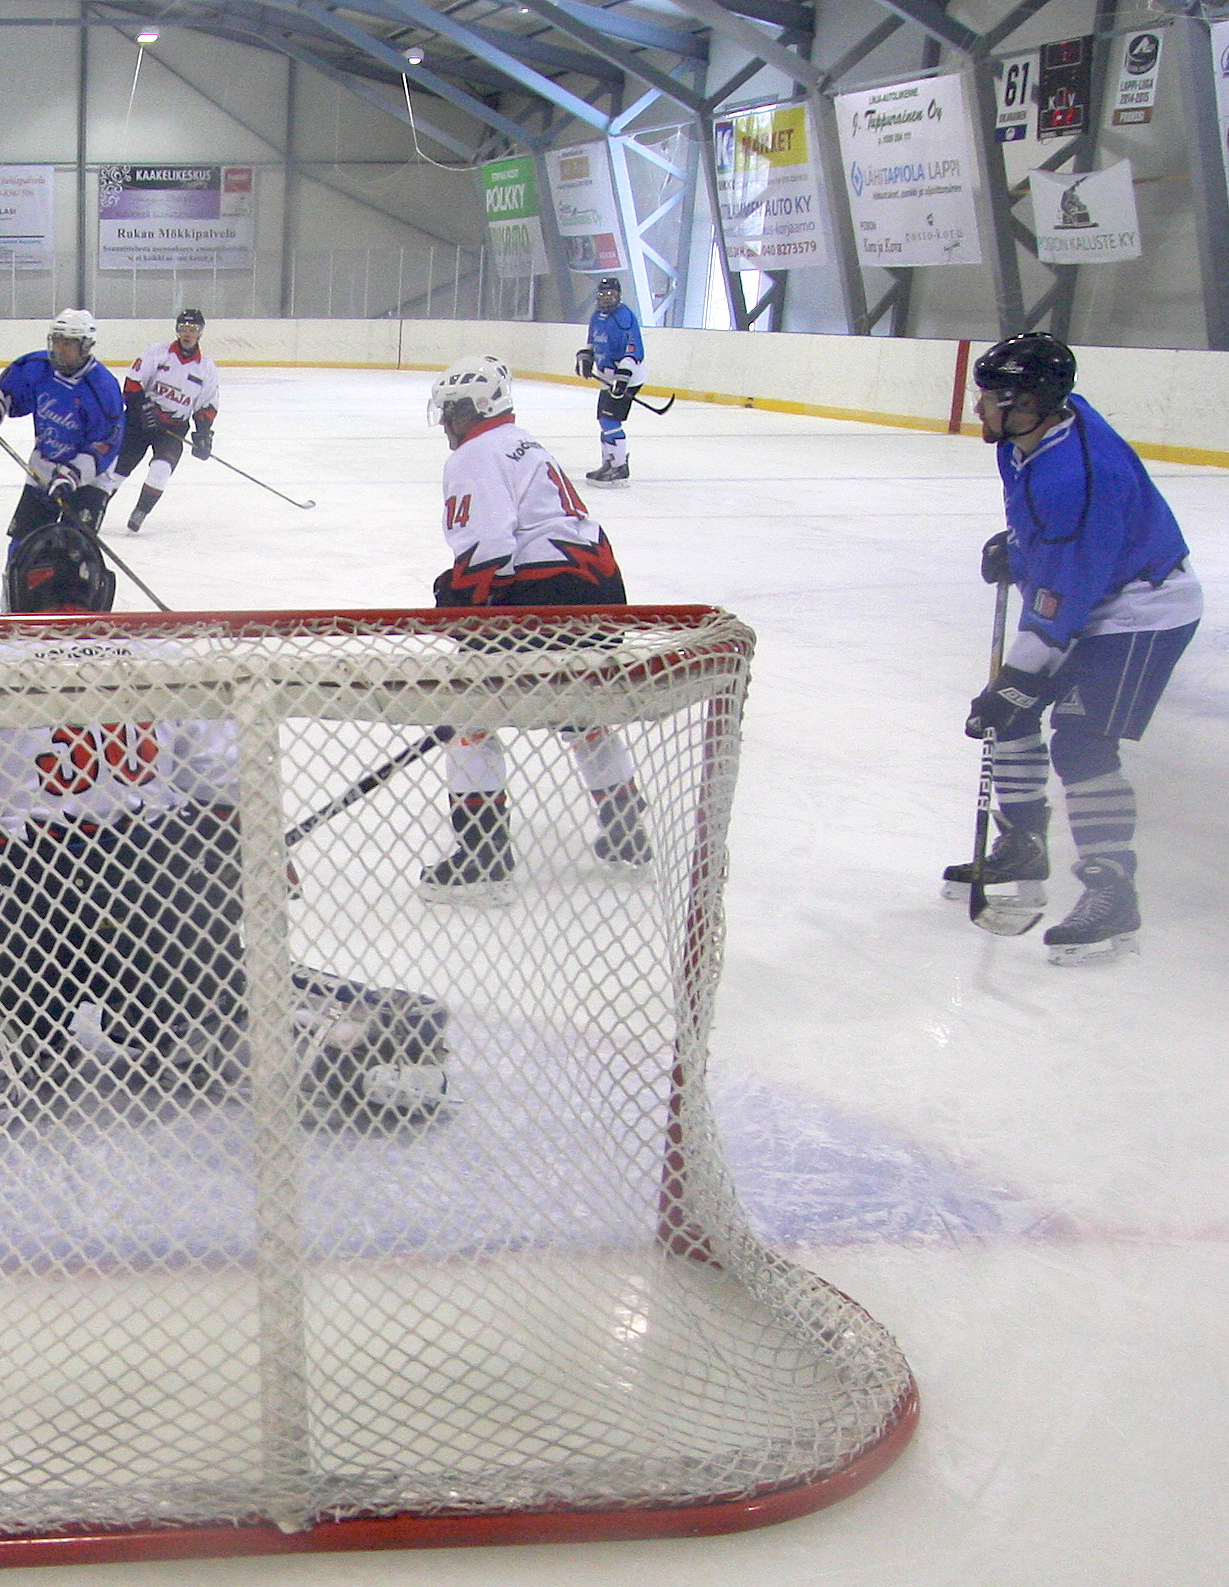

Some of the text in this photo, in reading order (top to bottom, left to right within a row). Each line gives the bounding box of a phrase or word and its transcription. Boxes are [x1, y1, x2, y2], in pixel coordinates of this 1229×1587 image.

[1004, 62, 1030, 107] 61
[135, 169, 212, 181] KAAKELIKESKUS
[928, 158, 960, 180] LAPPI
[765, 196, 792, 217] AUTO
[795, 195, 812, 214] KY
[117, 227, 237, 241] Rukan Mökkipalvelu
[444, 493, 472, 531] 14
